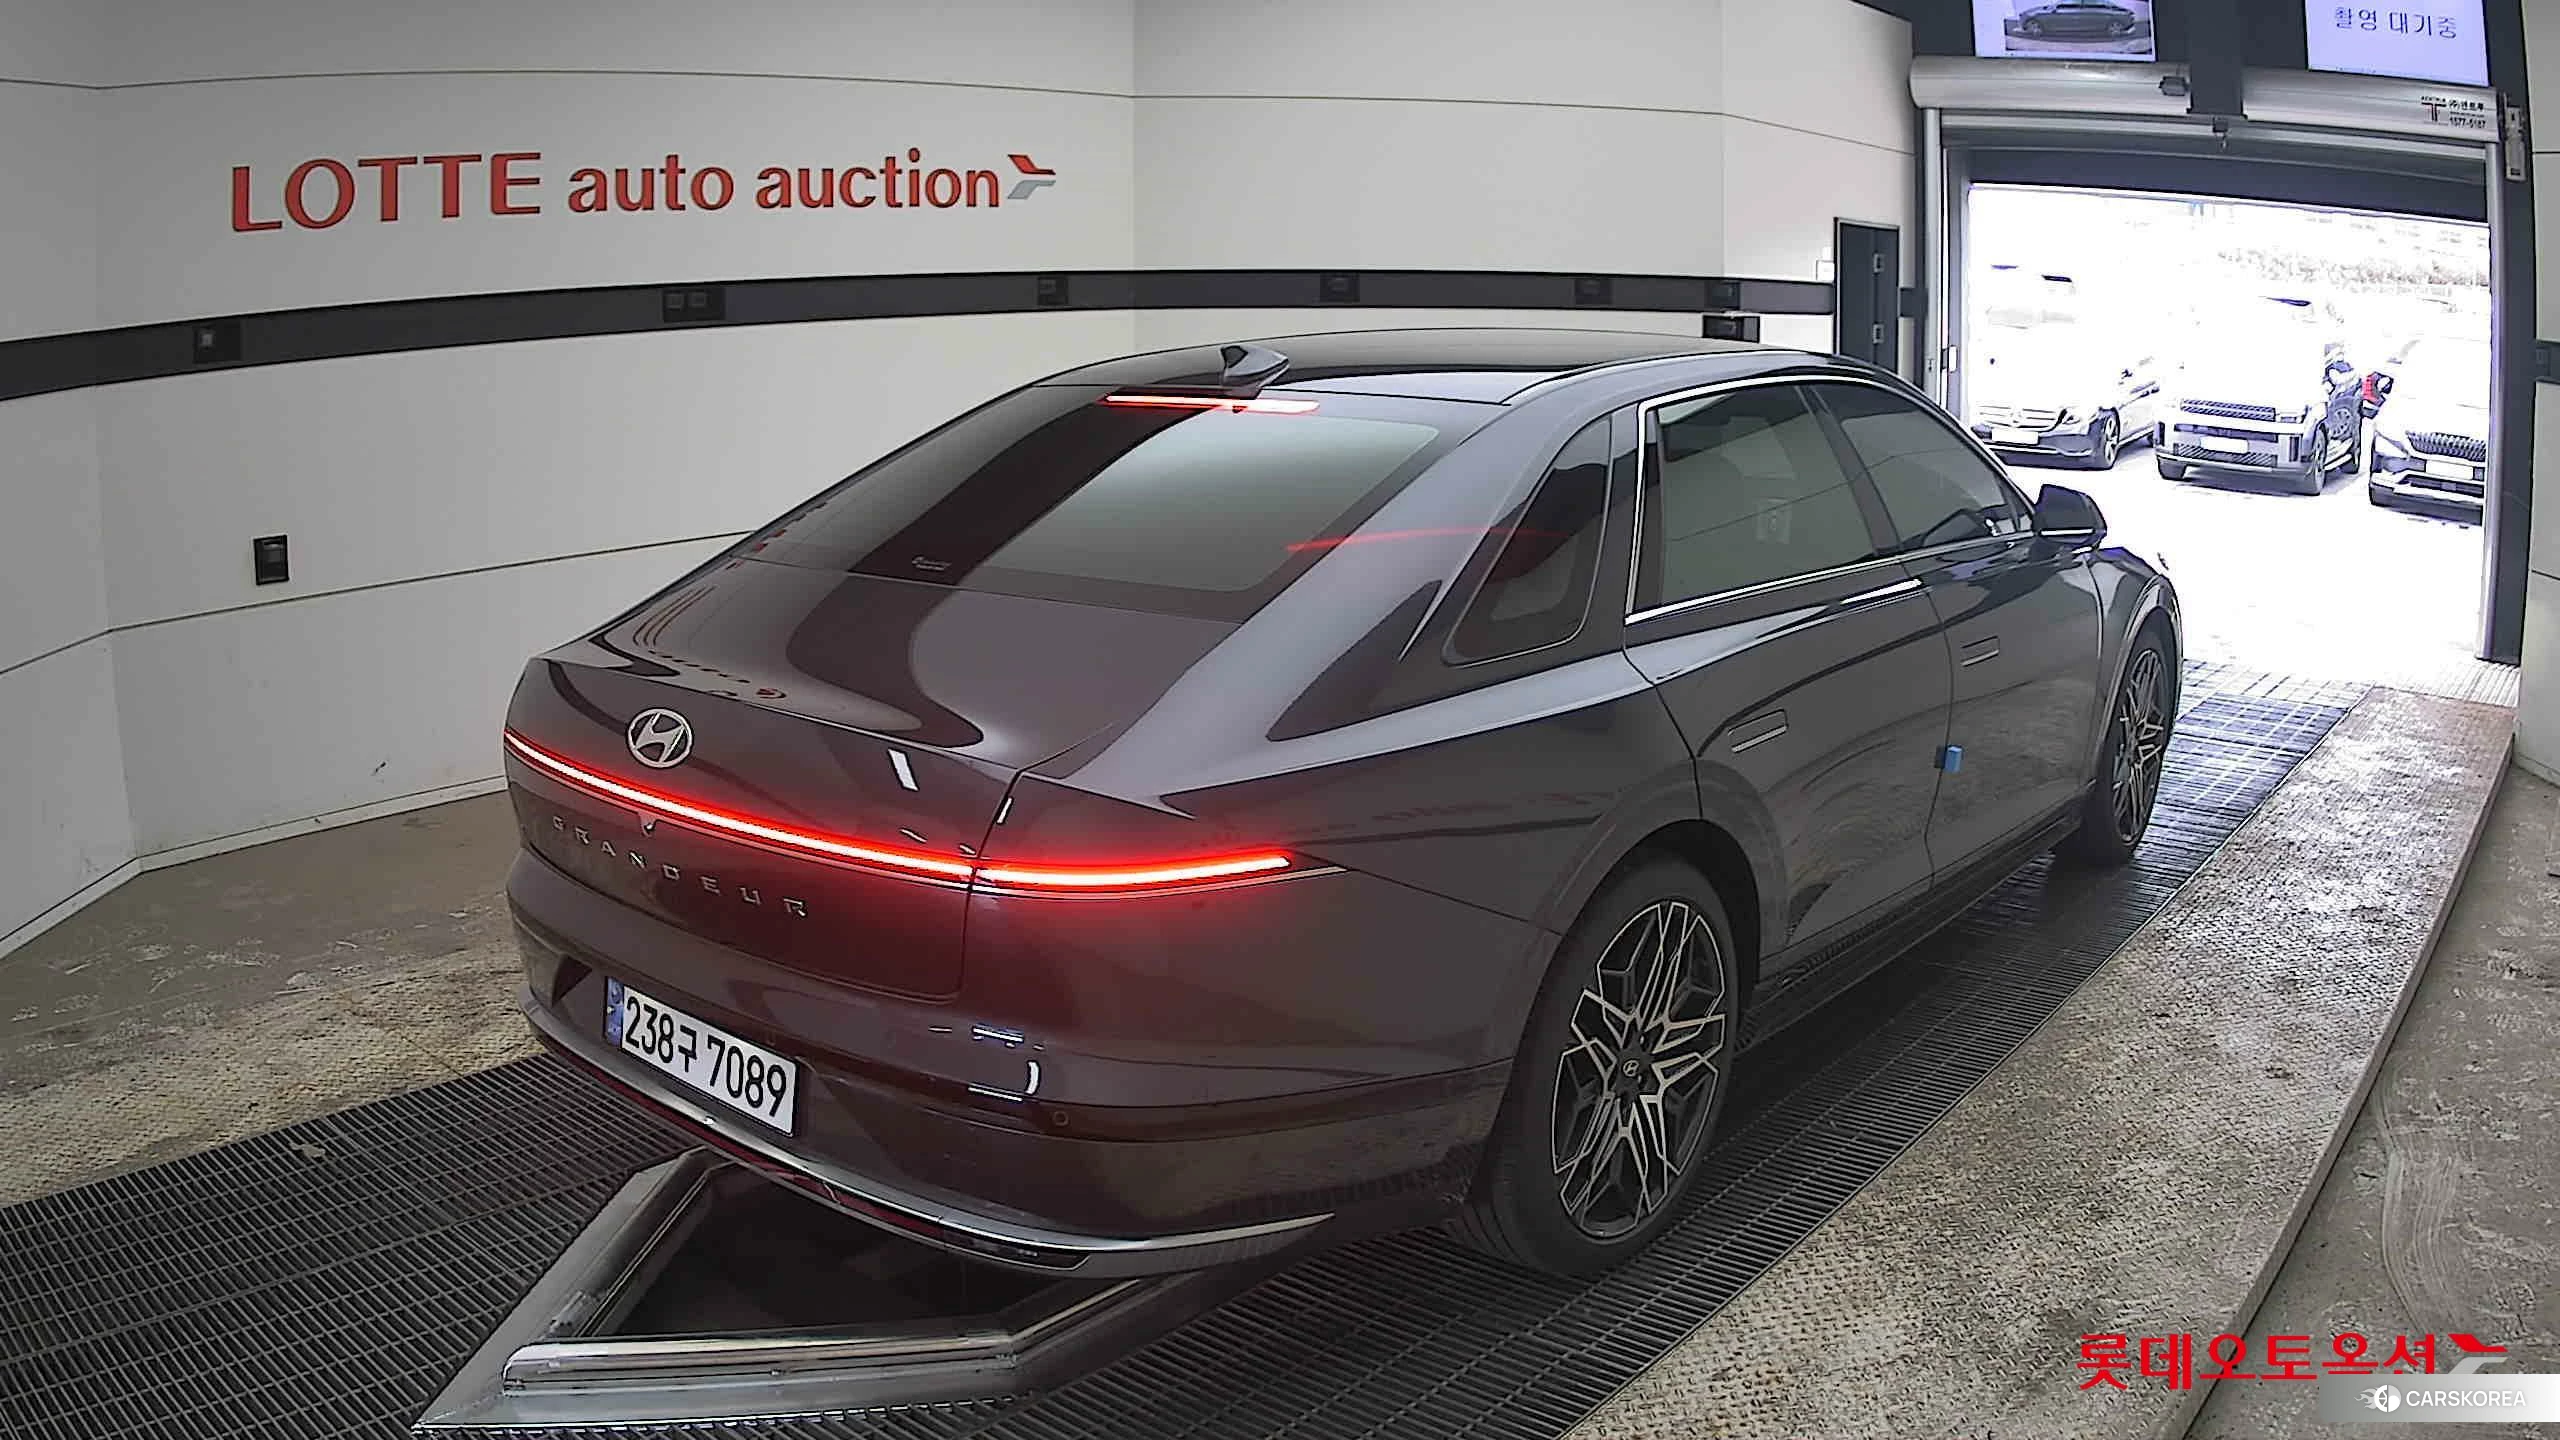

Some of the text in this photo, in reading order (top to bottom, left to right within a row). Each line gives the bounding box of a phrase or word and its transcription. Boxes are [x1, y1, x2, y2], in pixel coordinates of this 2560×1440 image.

[2335, 6, 2458, 39] 촬영 대기중
[231, 146, 1001, 233] LOTTE auto auction
[552, 815, 807, 917] GRANDEUR
[625, 996, 787, 1117] 238구 7089
